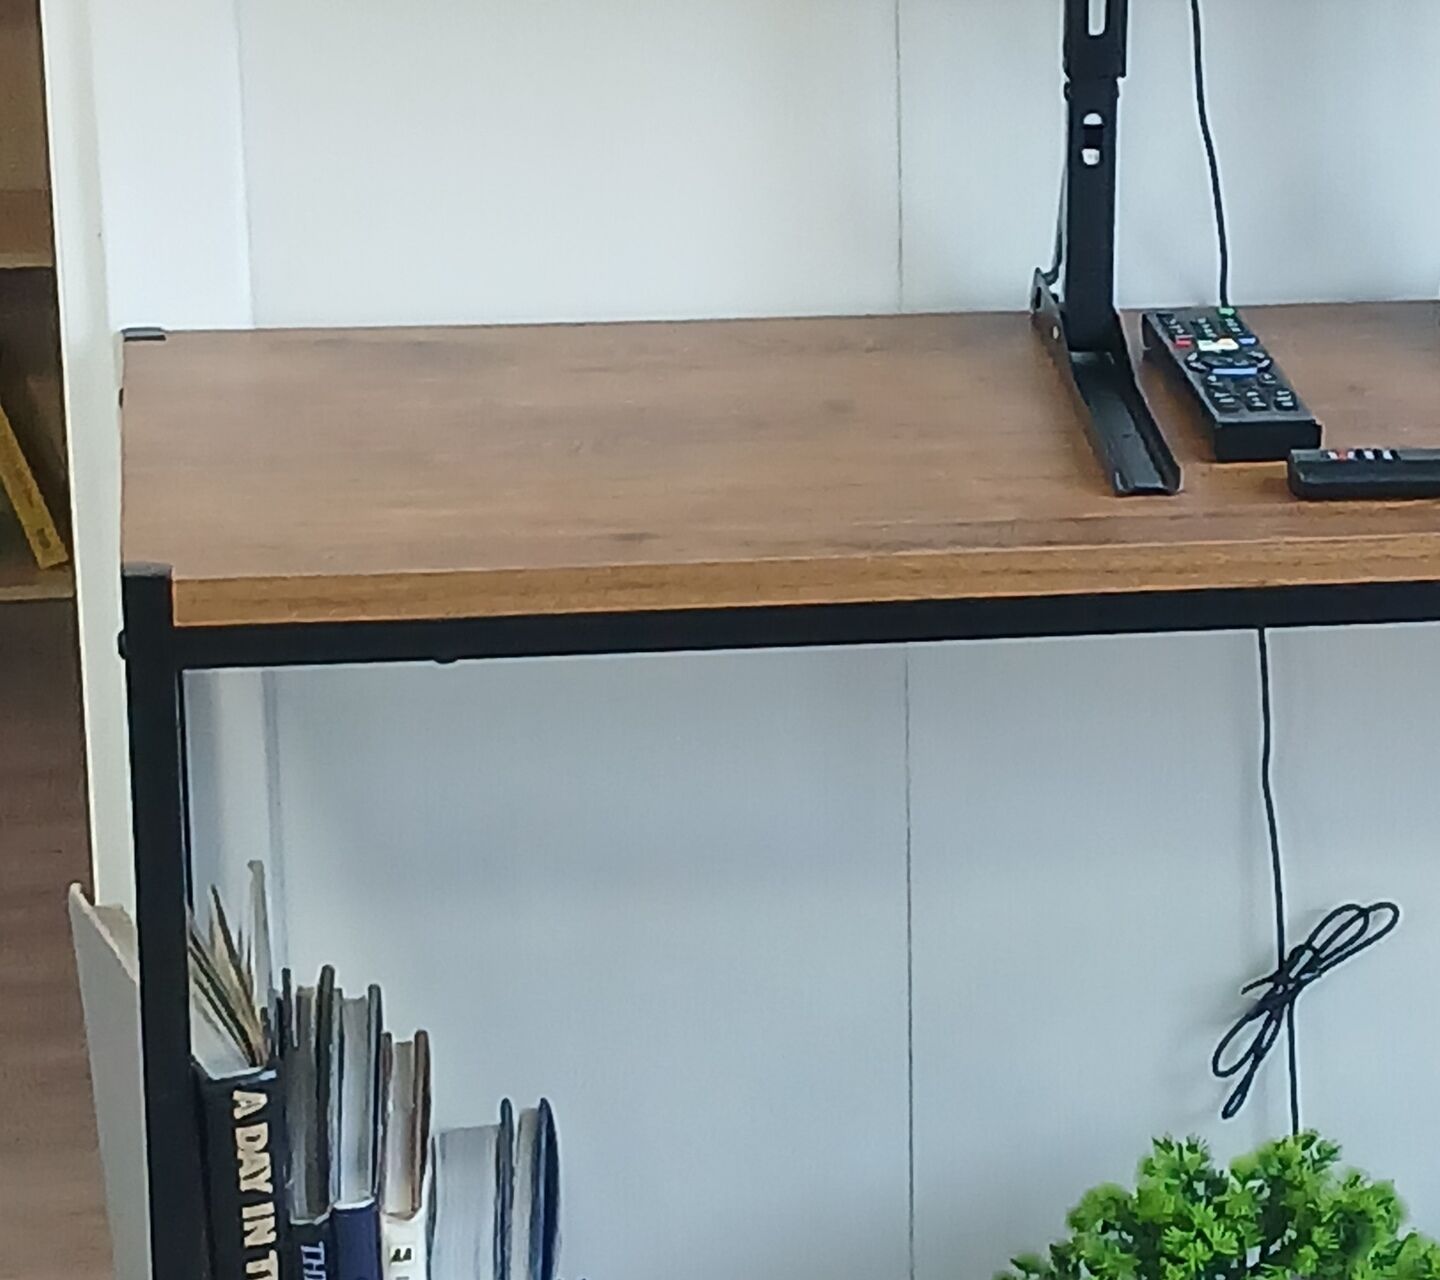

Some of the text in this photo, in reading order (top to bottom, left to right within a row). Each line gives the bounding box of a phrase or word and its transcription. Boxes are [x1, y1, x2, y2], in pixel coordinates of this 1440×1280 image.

[233, 1090, 268, 1120] A
[235, 1122, 273, 1193] DAY
[242, 1201, 277, 1248] IN
